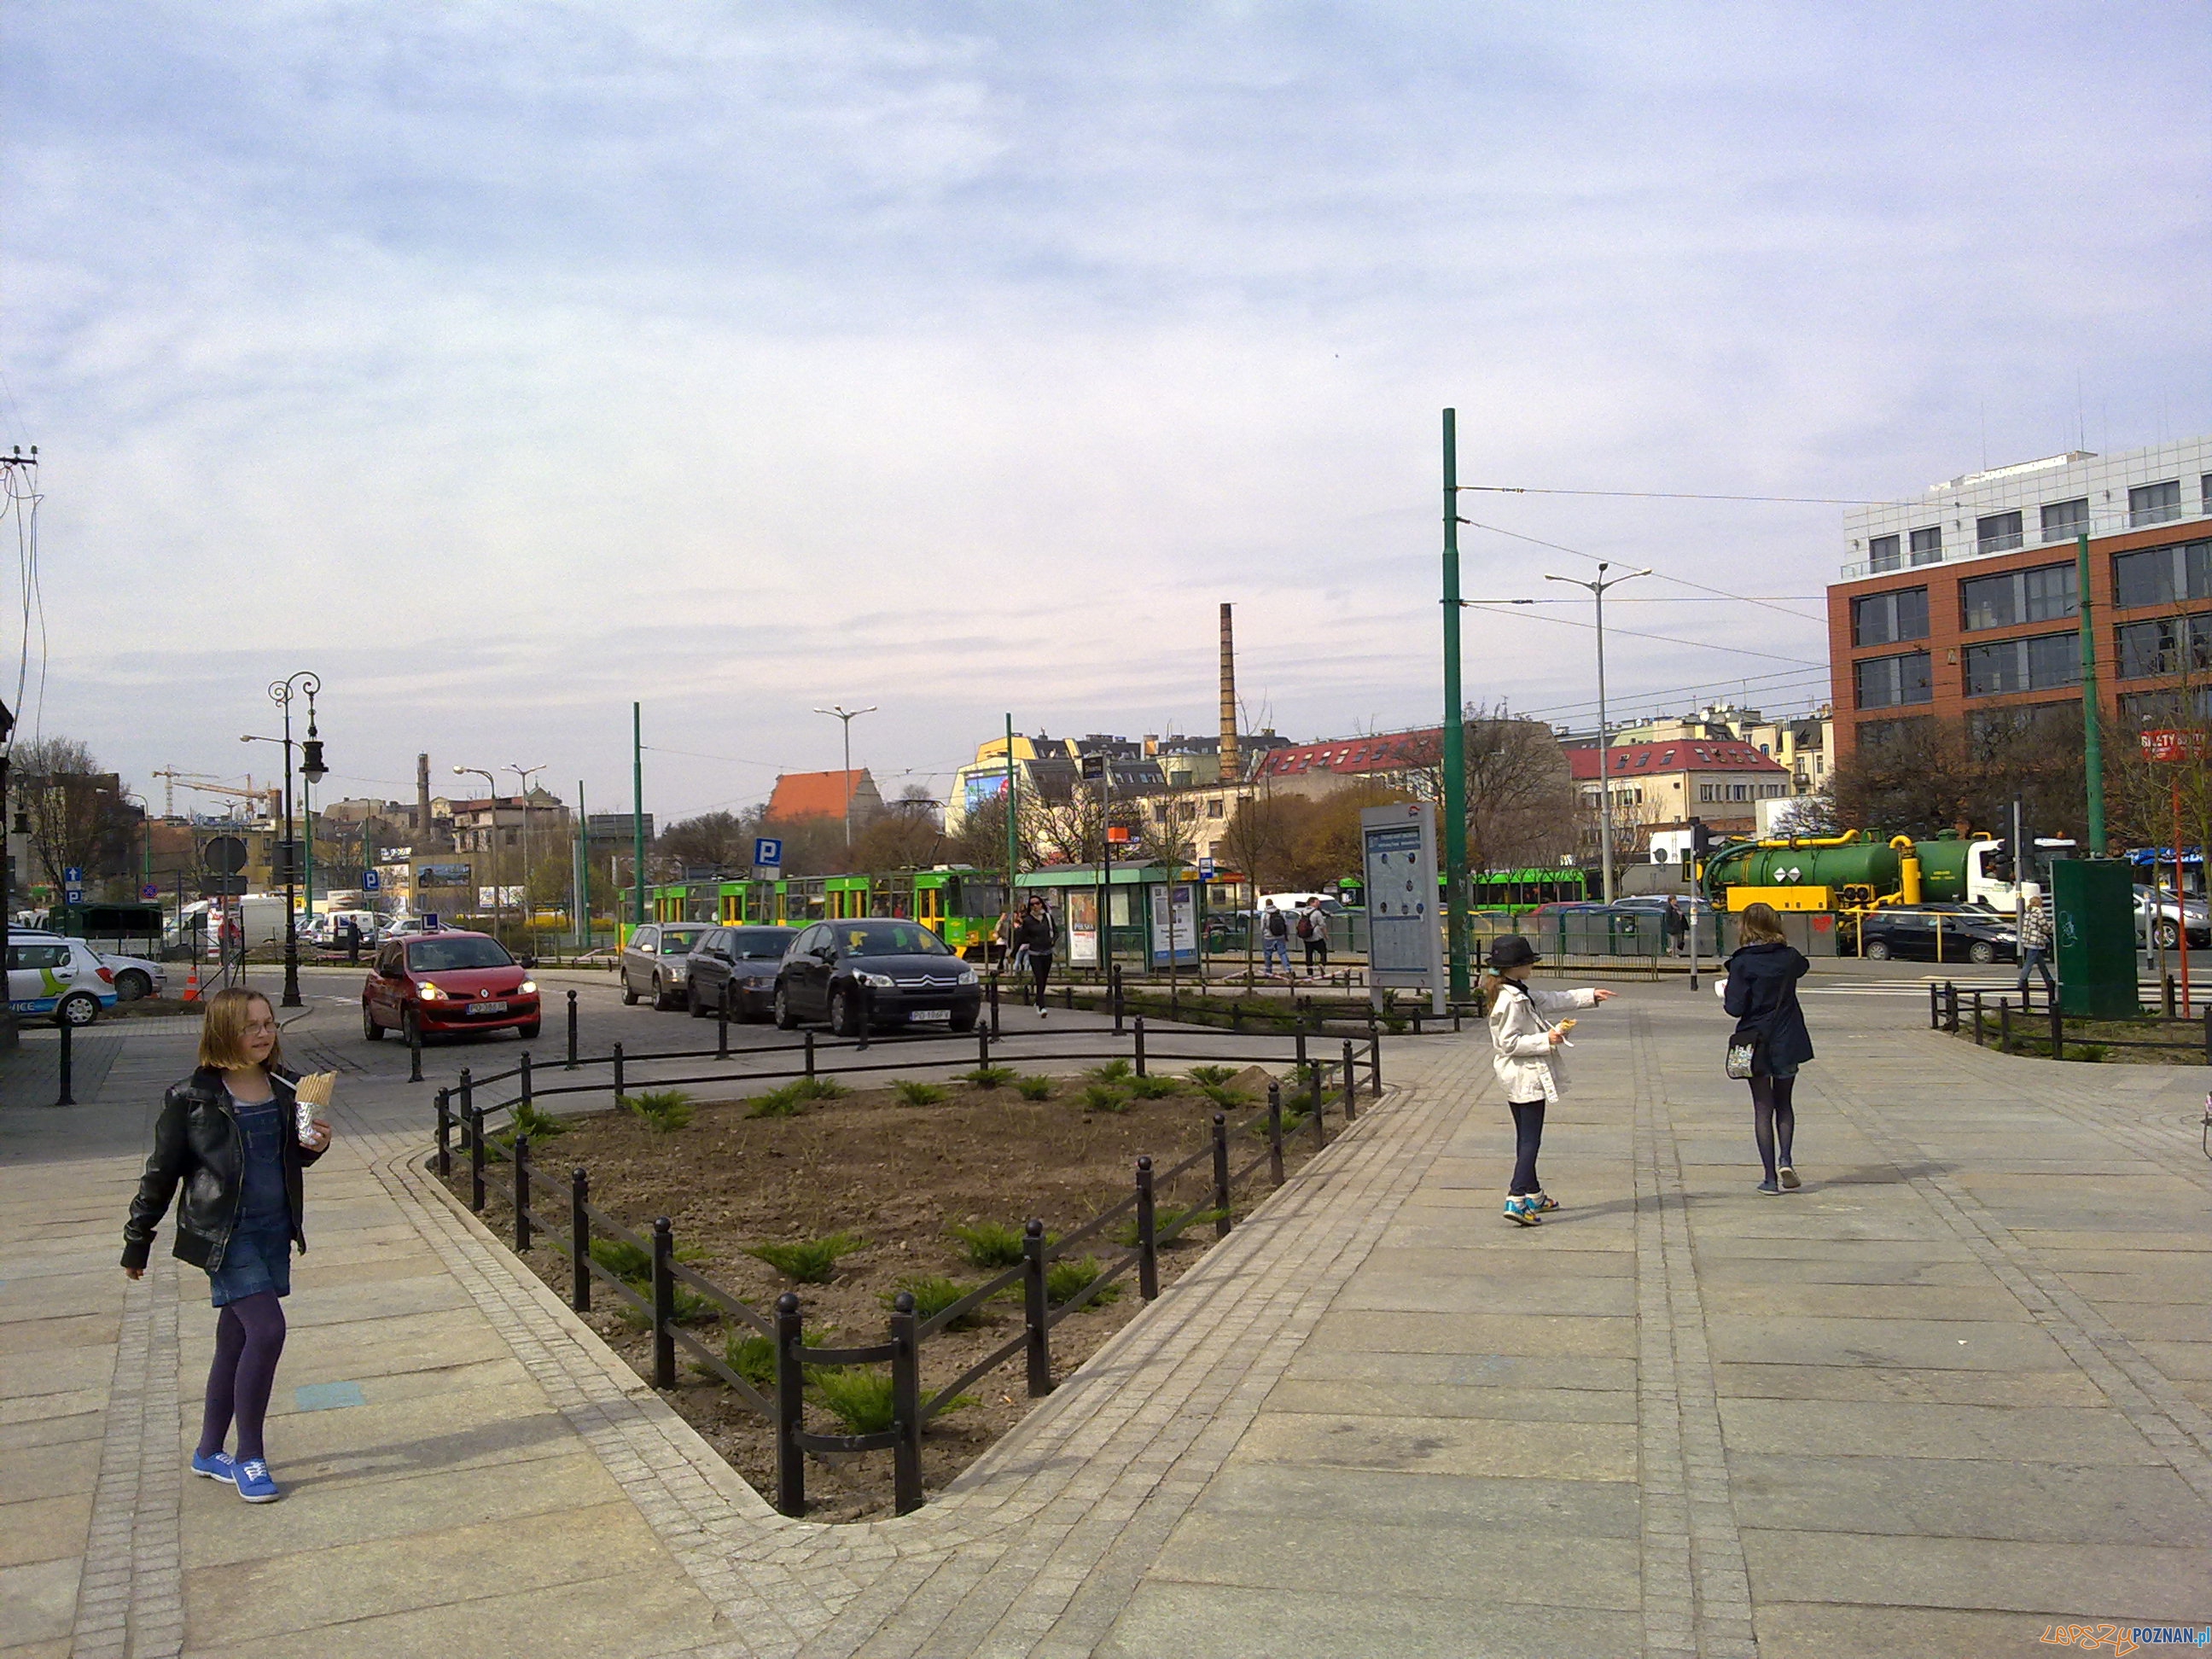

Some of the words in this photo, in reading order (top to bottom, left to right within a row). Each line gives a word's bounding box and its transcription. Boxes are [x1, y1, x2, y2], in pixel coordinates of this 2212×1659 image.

[760, 841, 776, 863] P
[367, 872, 376, 887] P
[423, 914, 437, 930] L
